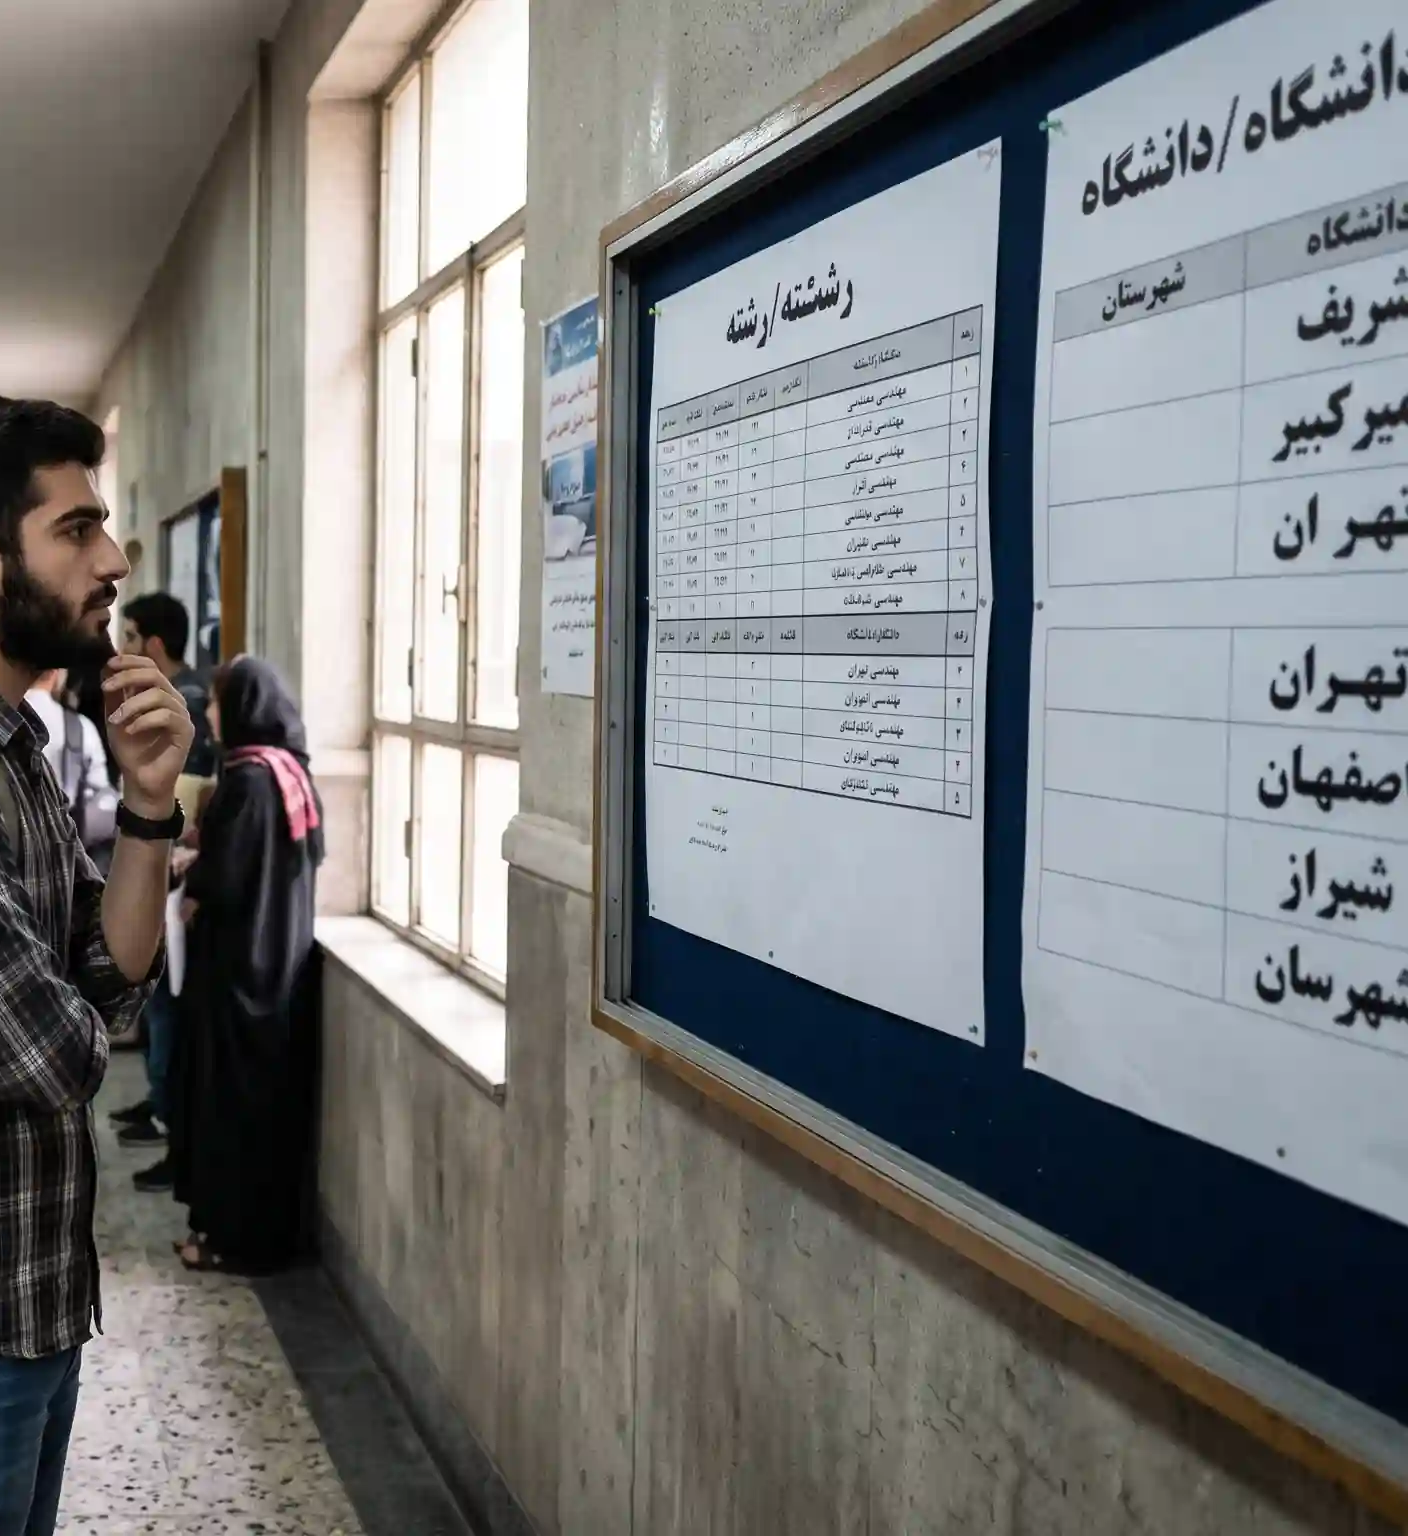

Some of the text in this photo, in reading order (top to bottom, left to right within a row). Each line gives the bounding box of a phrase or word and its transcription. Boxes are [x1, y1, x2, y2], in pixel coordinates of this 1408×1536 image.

[1102, 261, 1186, 321] شهرستان
[1269, 644, 1408, 713] تهران
[1257, 744, 1408, 812] صفهان
[1279, 848, 1393, 920] شیراز
